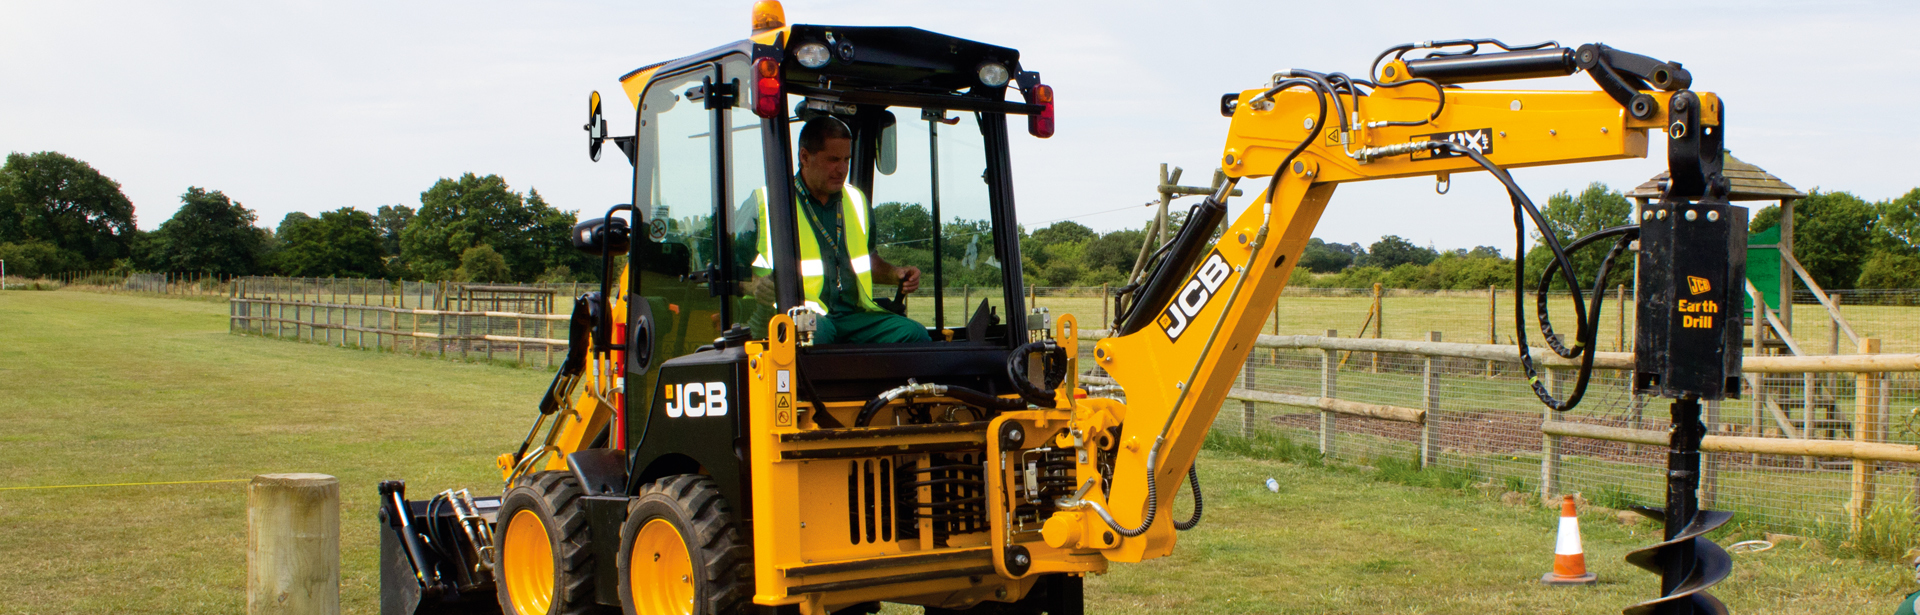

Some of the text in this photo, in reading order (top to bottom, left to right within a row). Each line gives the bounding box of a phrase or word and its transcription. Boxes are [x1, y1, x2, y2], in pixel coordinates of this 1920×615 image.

[1690, 277, 1710, 293] JCB
[1166, 254, 1230, 338] JCB
[1678, 299, 1718, 313] Earth
[1683, 315, 1712, 328] Drill
[665, 381, 728, 418] JCB
